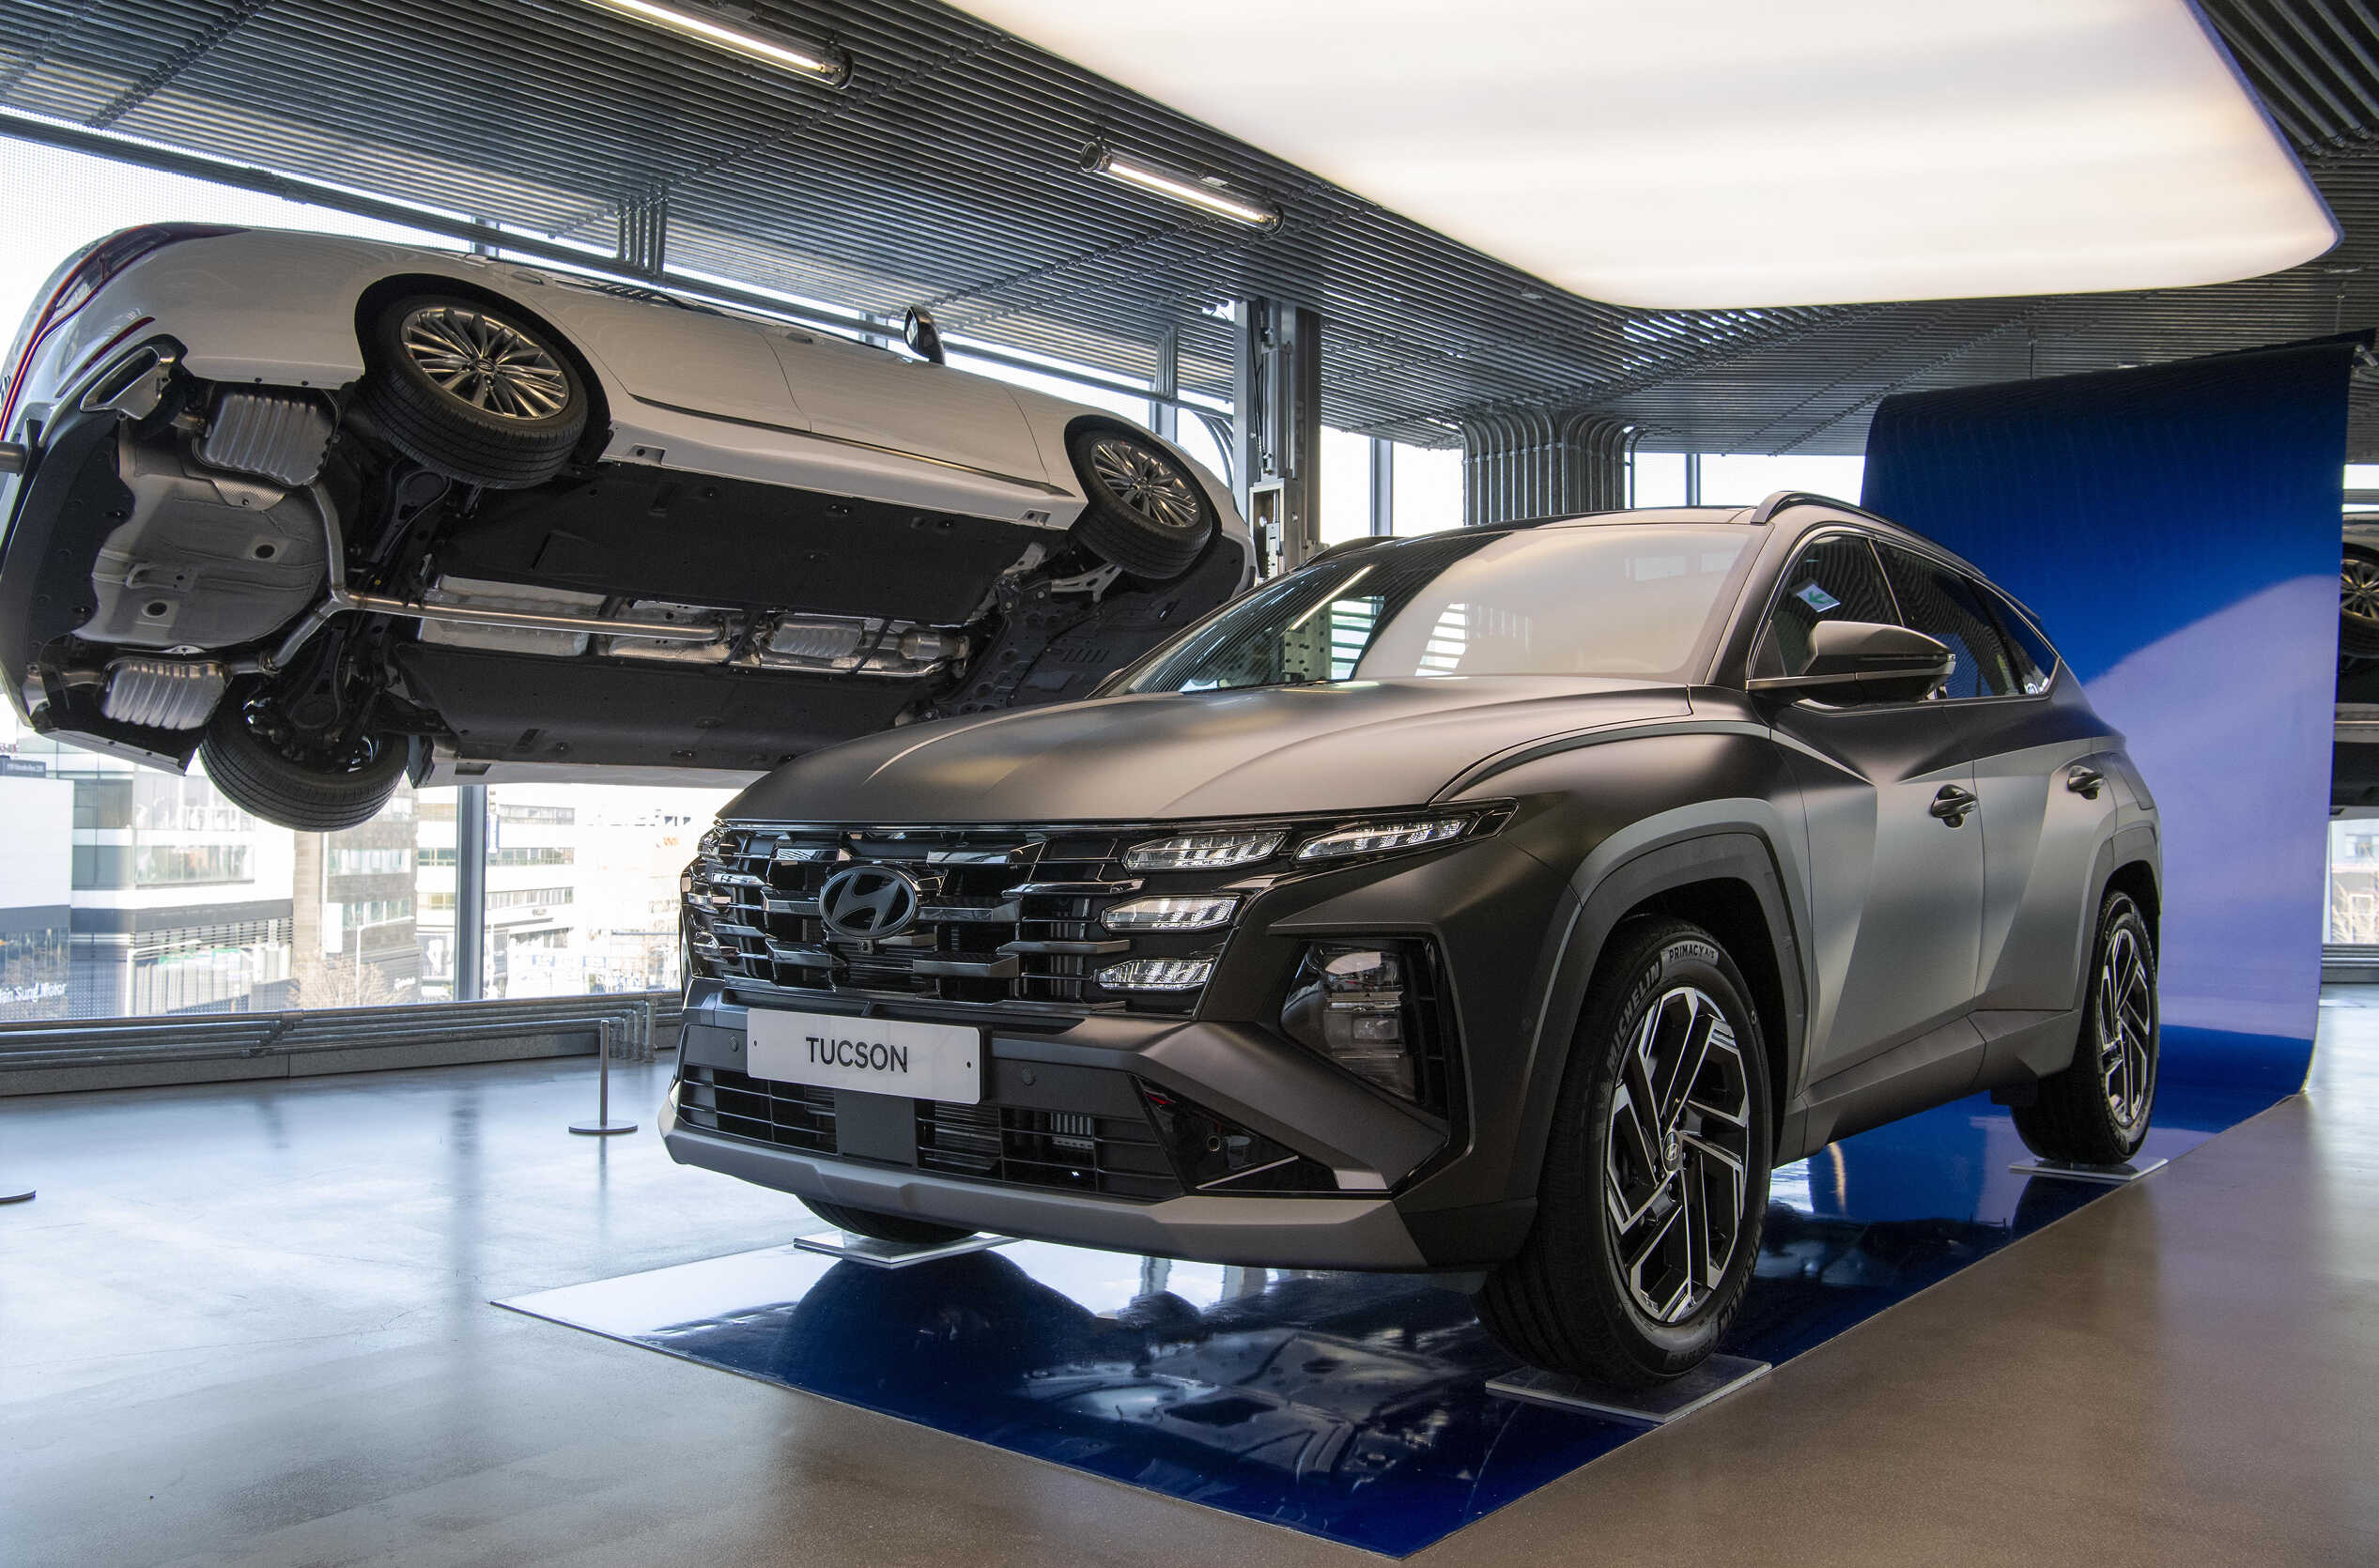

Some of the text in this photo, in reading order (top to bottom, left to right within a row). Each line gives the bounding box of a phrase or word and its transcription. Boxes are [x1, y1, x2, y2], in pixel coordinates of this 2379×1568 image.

[1669, 944, 1704, 961] PRIMACY
[1606, 961, 1661, 1076] MICHELIN
[806, 1037, 907, 1073] TUCSON
